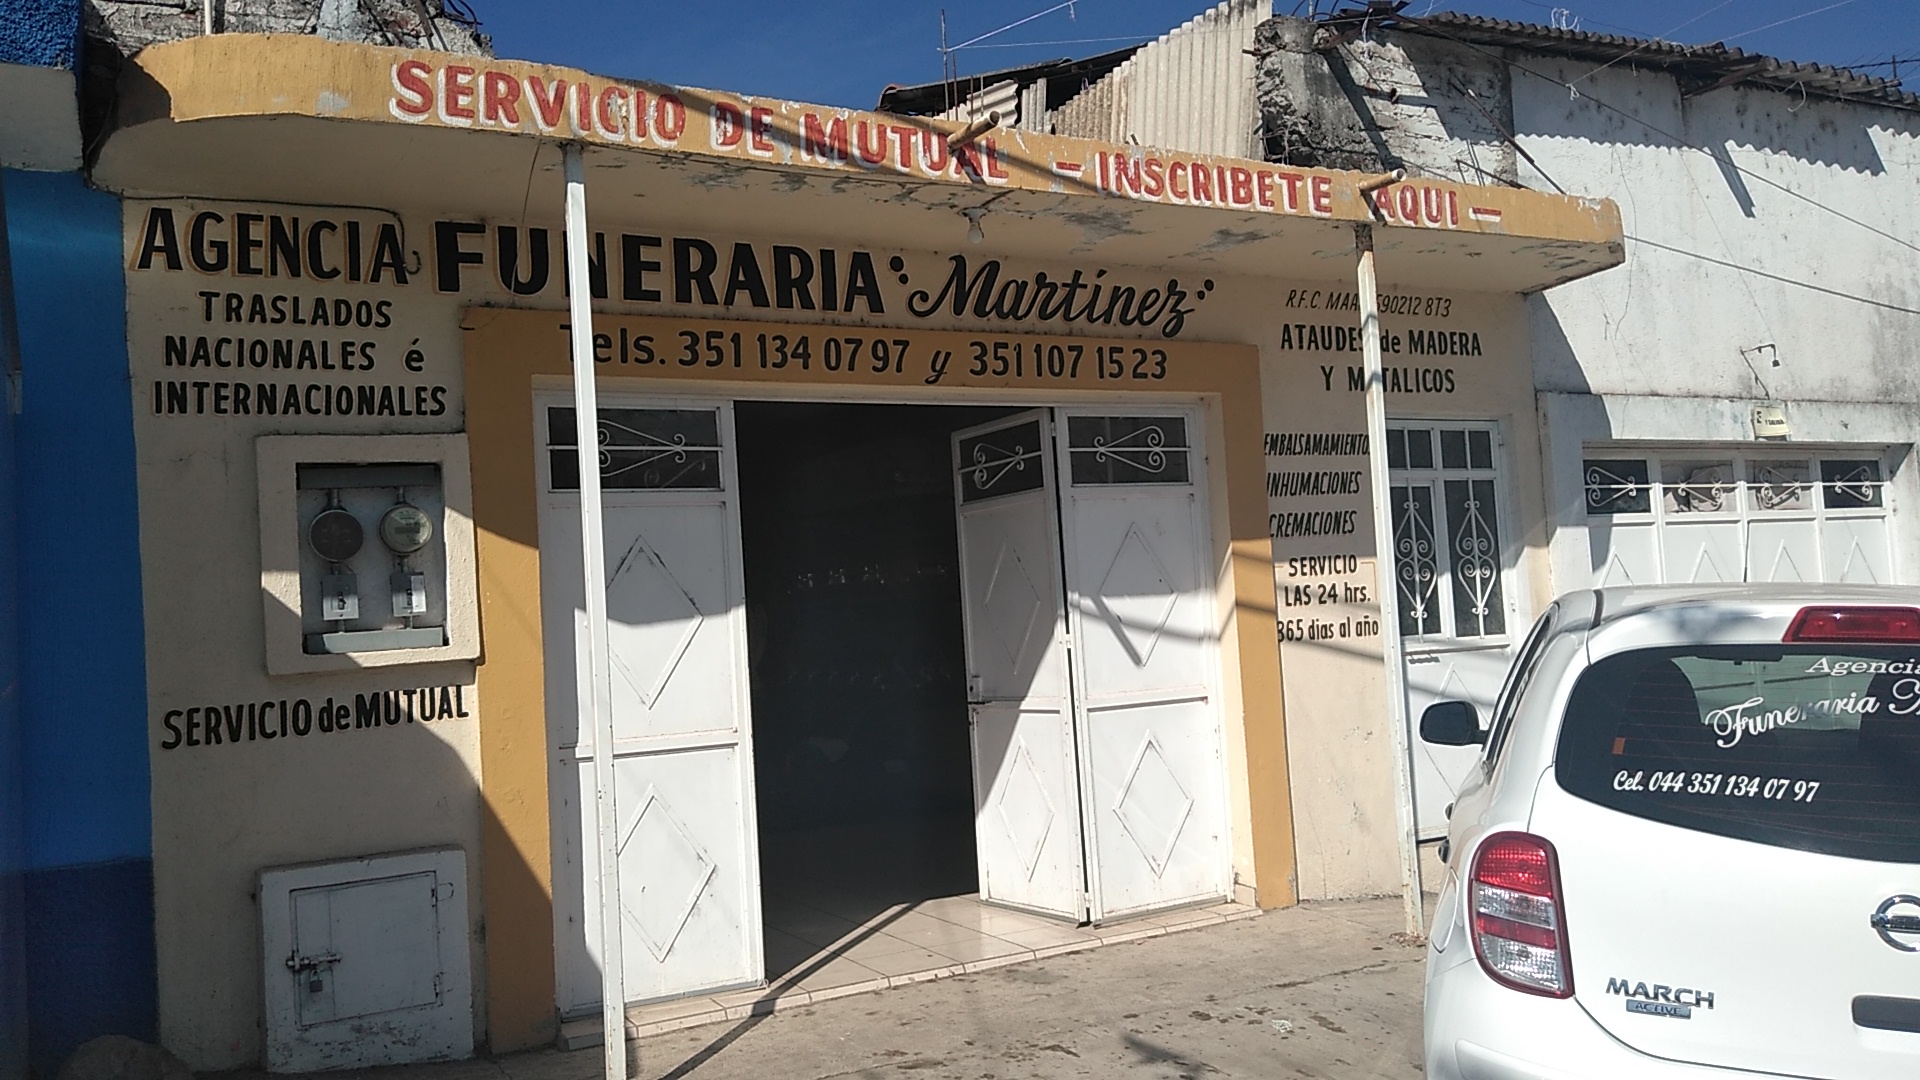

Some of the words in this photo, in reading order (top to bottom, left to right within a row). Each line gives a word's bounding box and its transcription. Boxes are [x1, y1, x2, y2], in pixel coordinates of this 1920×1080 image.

[389, 60, 686, 147] SERVICIO
[710, 101, 774, 157] DE
[799, 112, 1009, 185] MUTUAL
[1095, 151, 1333, 218] INSCRIBETE
[1369, 184, 1459, 229] AQUI
[129, 206, 409, 286] AGENCIA
[433, 220, 886, 315] FUNERARIA
[907, 254, 1196, 338] Martínez
[198, 291, 393, 328] TRASLADOS
[1424, 297, 1452, 318] 8T3
[164, 335, 377, 371] NACIONALES
[404, 338, 426, 372] é
[678, 330, 743, 369] 351
[756, 333, 812, 370] 134
[924, 350, 952, 385] y
[969, 341, 1022, 378] 351
[1033, 343, 1084, 378] 107
[1380, 328, 1401, 354] de
[1408, 329, 1482, 356] MADERA
[1320, 365, 1335, 391] Y
[1347, 366, 1456, 393] MTALICOS
[154, 381, 447, 417] INTERNACIONALES
[1266, 470, 1363, 498] INHUMACIONES
[1268, 509, 1358, 538] CREMACIONES
[1288, 554, 1357, 577] SERVICIO
[1284, 584, 1312, 607] LAS
[1317, 582, 1339, 605] 24
[1344, 581, 1371, 603] hrs.
[1339, 615, 1351, 638] al
[1355, 614, 1379, 637] año
[161, 699, 312, 750] SERVICIO
[318, 697, 350, 733] de
[355, 684, 469, 729] MUTUAL
[1704, 691, 1881, 749] Funeraria
[1613, 770, 1644, 791] Cel.
[1648, 771, 1686, 793] 044
[1687, 772, 1723, 795] 351
[1724, 775, 1761, 798] 134
[1763, 779, 1790, 800] 07
[1793, 780, 1820, 803] 97
[1605, 977, 1714, 1010] MARCH
[1635, 1002, 1681, 1015] ACTIVE
